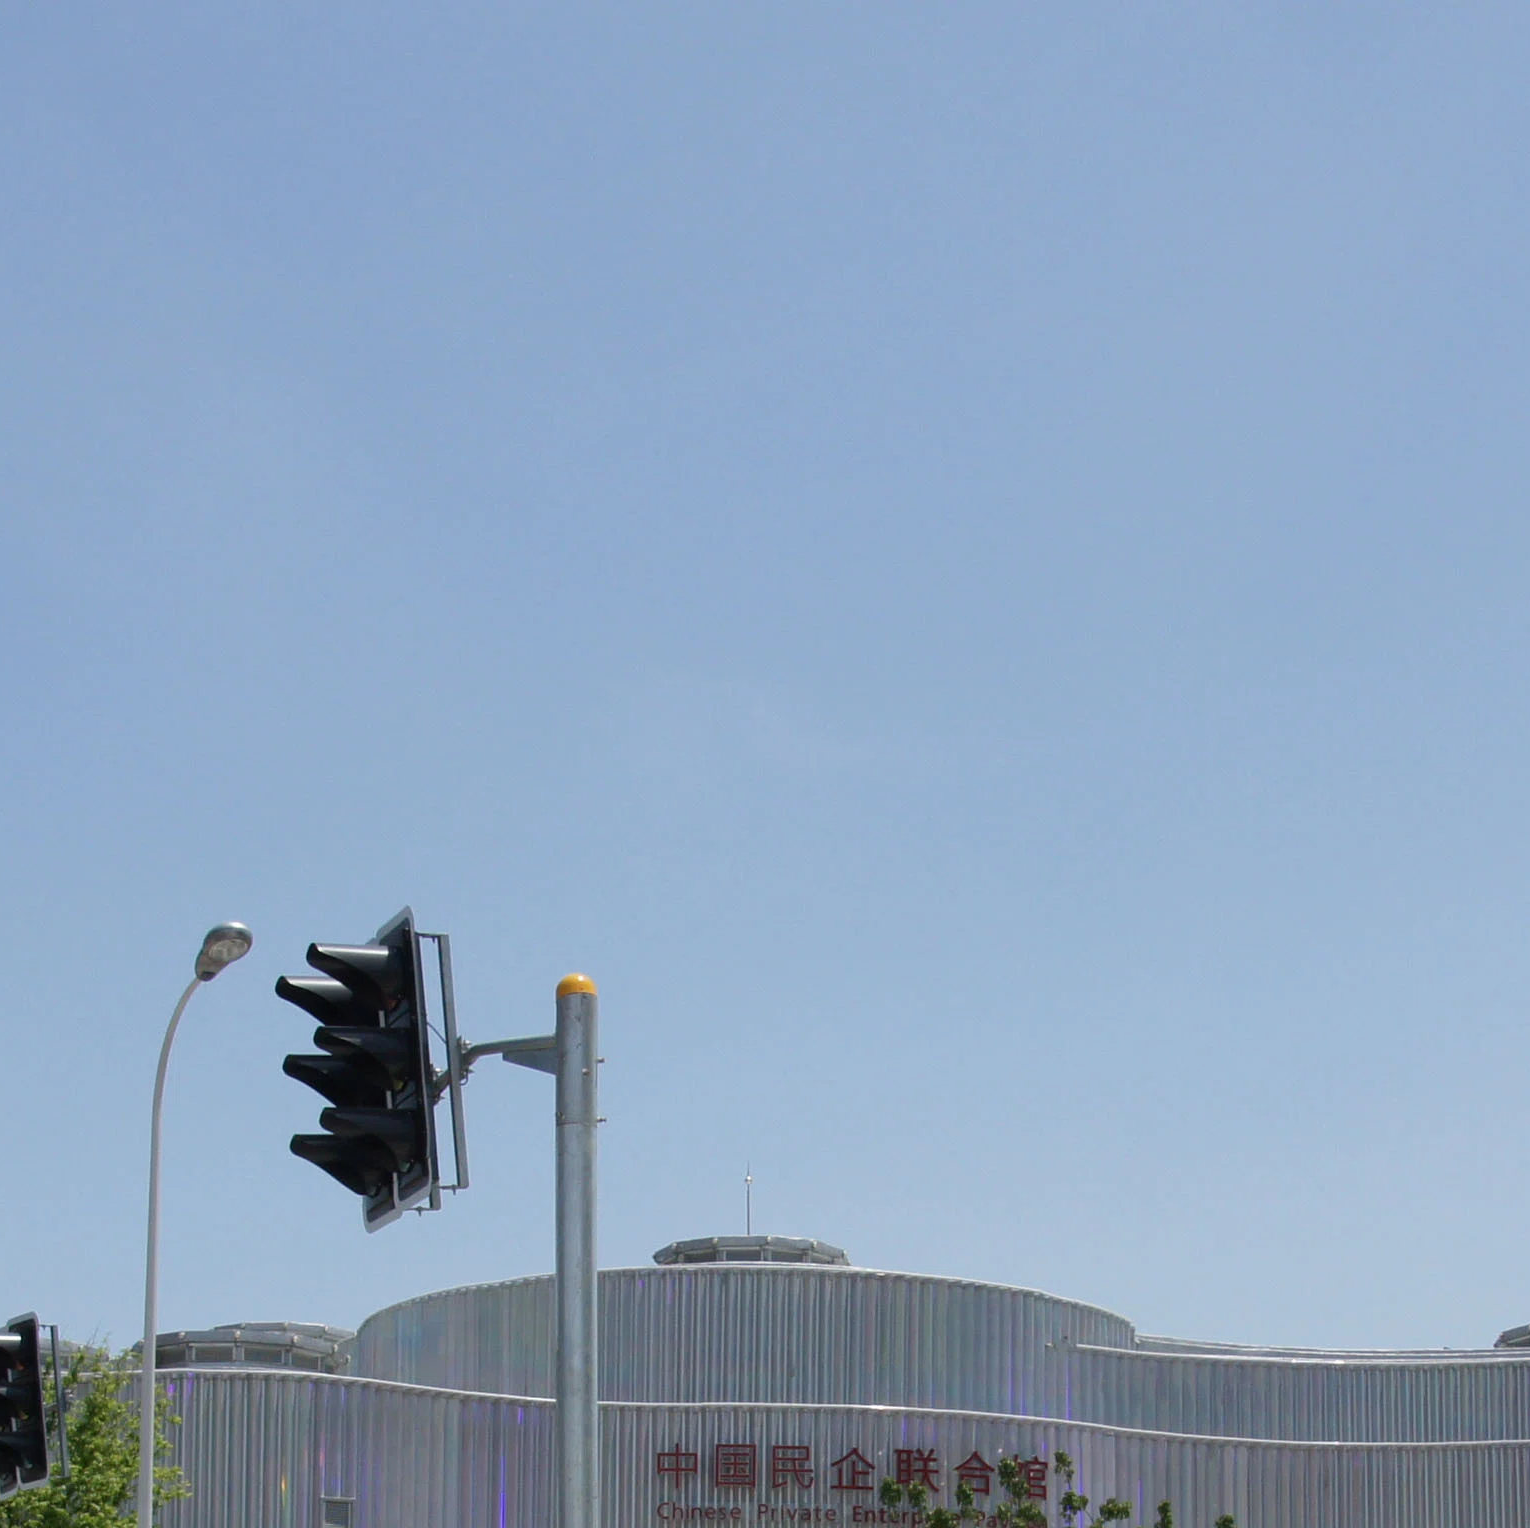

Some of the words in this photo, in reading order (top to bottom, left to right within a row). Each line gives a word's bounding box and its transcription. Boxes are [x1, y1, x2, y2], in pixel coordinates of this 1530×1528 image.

[657, 1443, 1049, 1500] 中国民企联合馆
[656, 1502, 742, 1521] Chinese
[757, 1503, 837, 1522] Private
[852, 1505, 962, 1528] Enterpe
